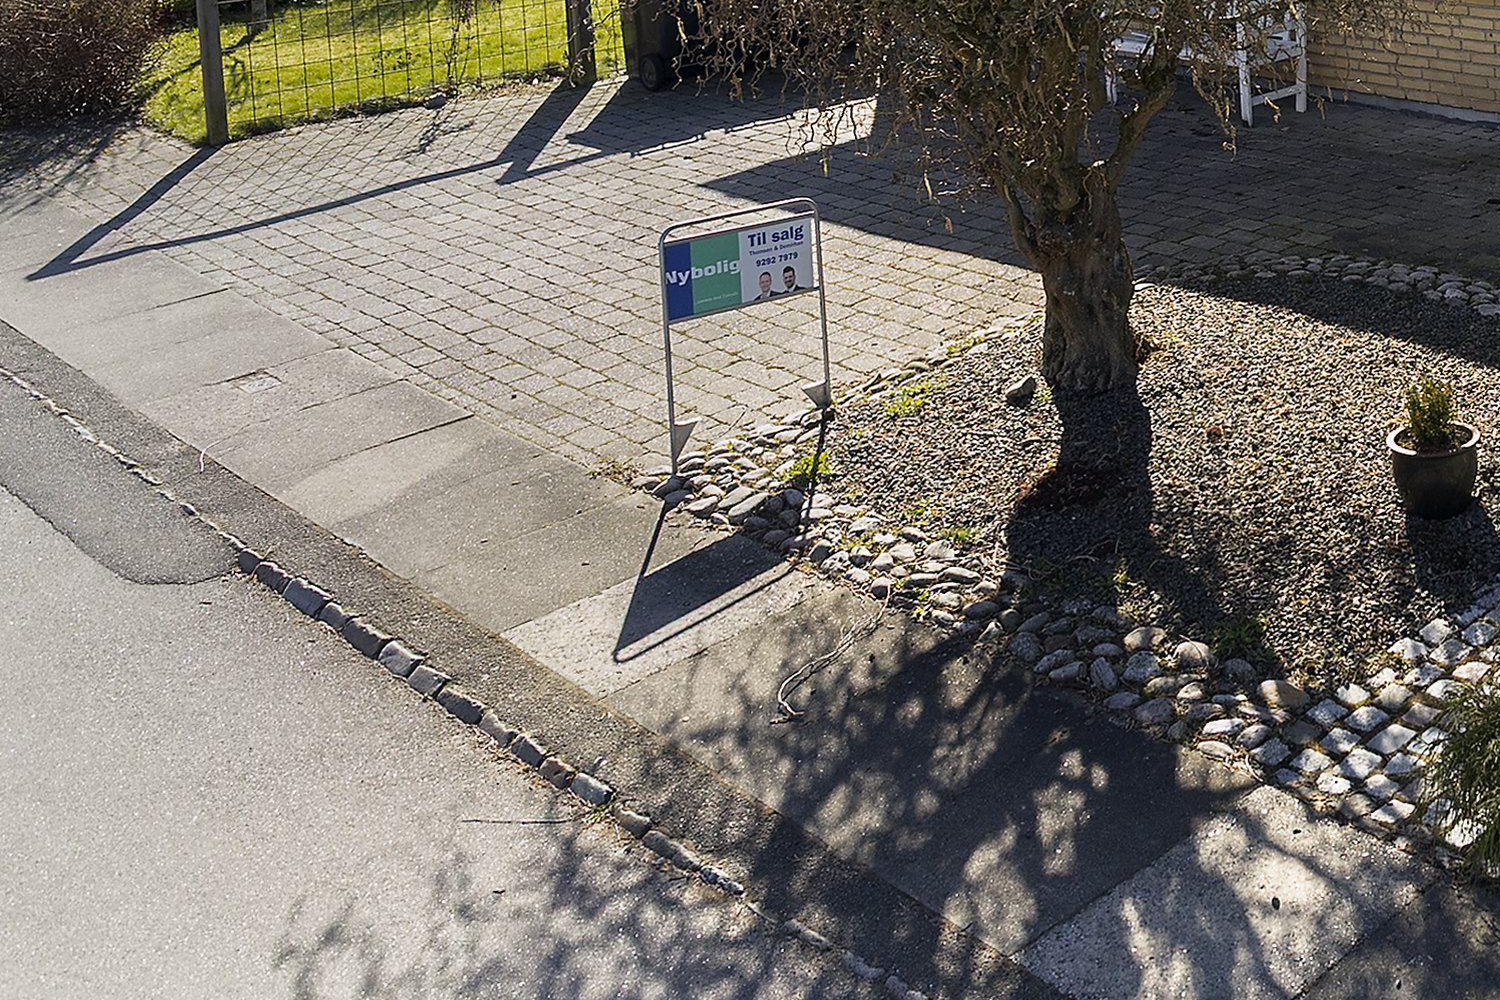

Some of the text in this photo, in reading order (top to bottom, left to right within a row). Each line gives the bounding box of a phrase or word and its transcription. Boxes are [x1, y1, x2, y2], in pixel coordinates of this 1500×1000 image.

[747, 225, 804, 247] Til salg
[756, 251, 798, 267] 9292 7979
[665, 259, 741, 286] Nybolig
